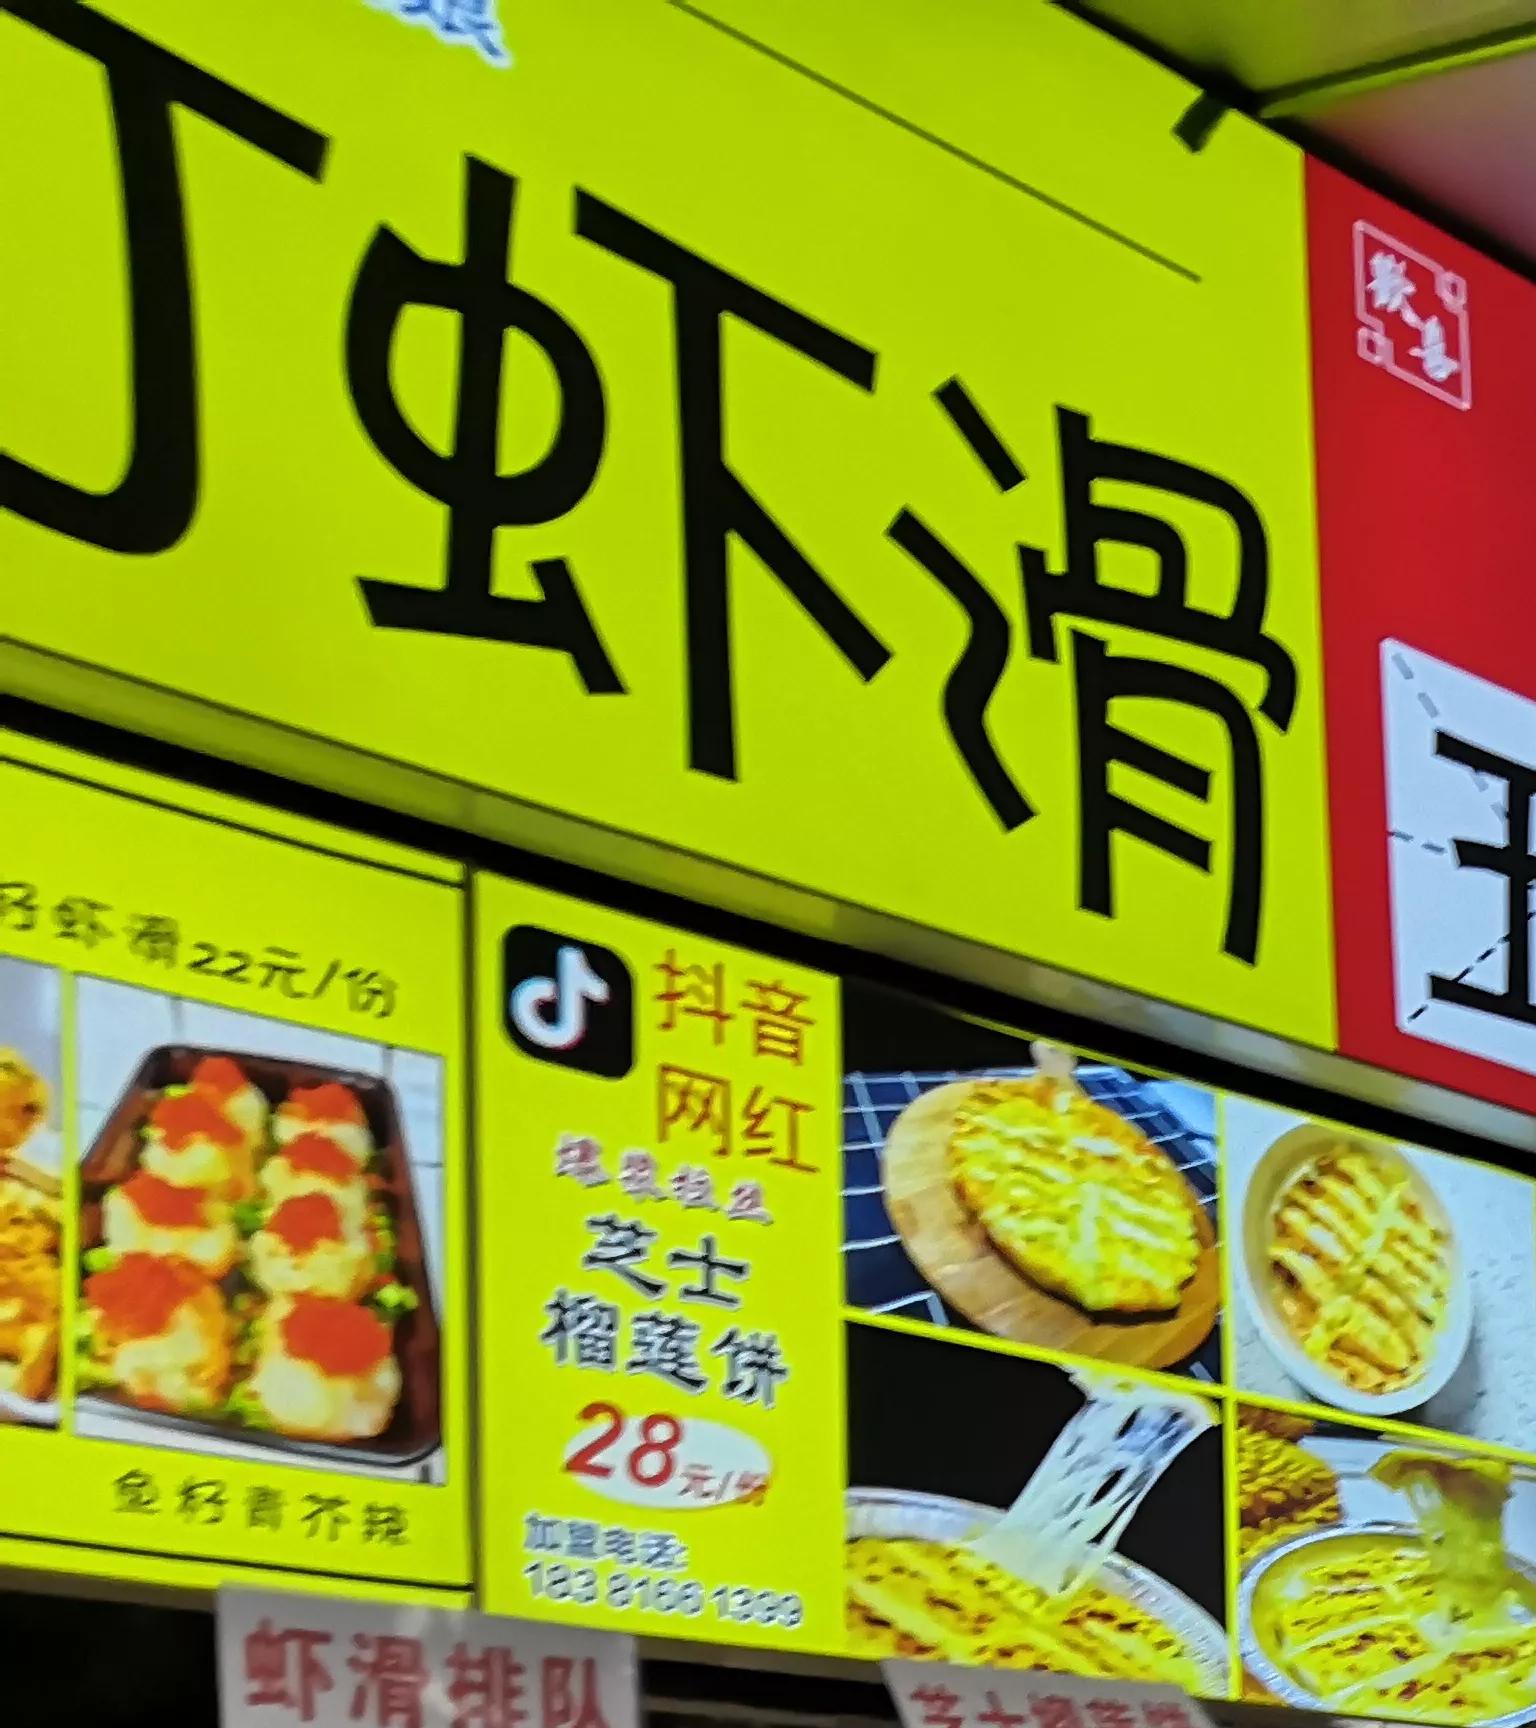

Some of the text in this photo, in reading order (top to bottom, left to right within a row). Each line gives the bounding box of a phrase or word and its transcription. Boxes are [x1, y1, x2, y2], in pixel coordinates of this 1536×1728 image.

[653, 947, 816, 1065] 抖音
[657, 1062, 820, 1173] 网红
[582, 1213, 750, 1310] 芝士
[540, 1287, 788, 1409] 榴莲饼
